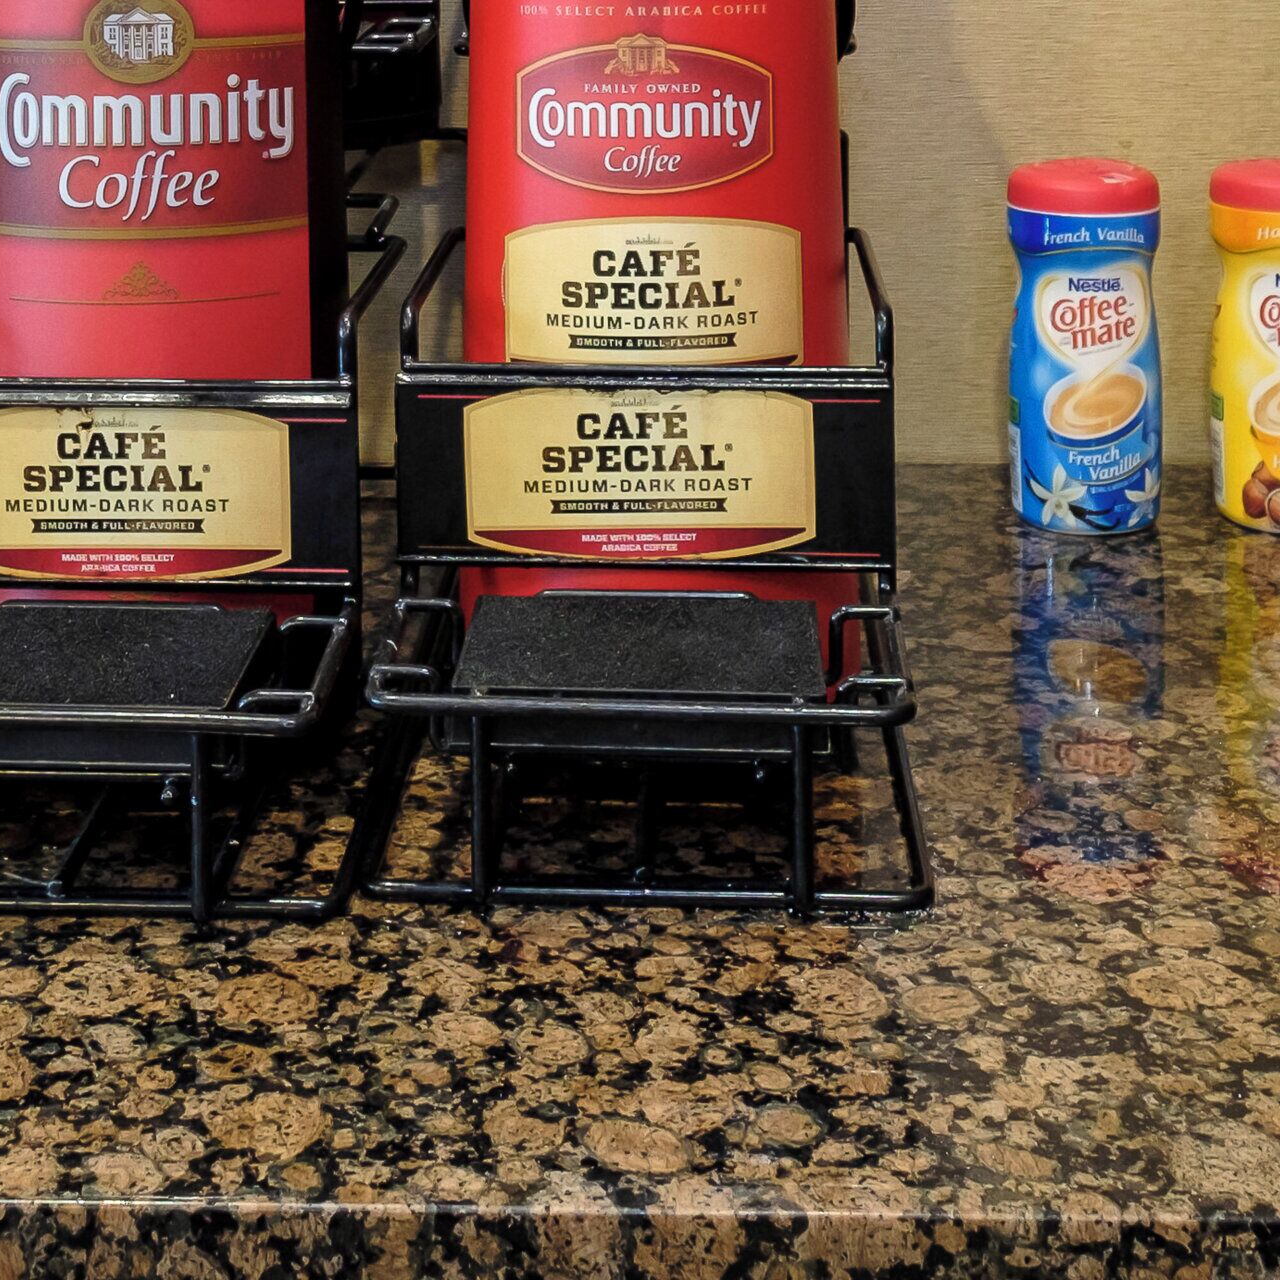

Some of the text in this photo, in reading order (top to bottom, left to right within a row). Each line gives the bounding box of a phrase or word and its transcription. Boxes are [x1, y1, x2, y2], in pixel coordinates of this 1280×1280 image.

[555, 6, 615, 16] SELECT
[625, 6, 702, 16] ARABICA
[712, 4, 767, 15] COFFEE
[584, 84, 701, 94] FAMILY OWNED
[528, 88, 761, 148] Community
[604, 145, 681, 178] Coffee
[58, 150, 220, 220] Coffee
[1044, 227, 1144, 245] French Vanilla
[593, 242, 700, 277] CAFÉ
[546, 311, 759, 330] MEDIUM-DARK ROAST
[1071, 316, 1135, 349] mate
[576, 336, 728, 348] SMOOTH & FULL-FLAVORED
[577, 405, 687, 440] CAFÉ
[57, 425, 166, 460] CAFÉ
[1069, 446, 1120, 466] French
[1089, 452, 1141, 480] Vanilla
[524, 477, 752, 493] MEDIUM-DARK ROAST
[5, 498, 230, 513] MEDIUM-DARK ROAST
[559, 500, 718, 511] SMOOTH & FULL-FLAVORED
[40, 521, 195, 531] SMOOTH & FULL-FLAVORED
[581, 533, 696, 542] MADE WITH 100% SELECT
[601, 544, 678, 552] ARABICA COFFEE
[61, 553, 175, 562] MADE WITH 100% SELECT
[122, 564, 156, 573] COFFEE
